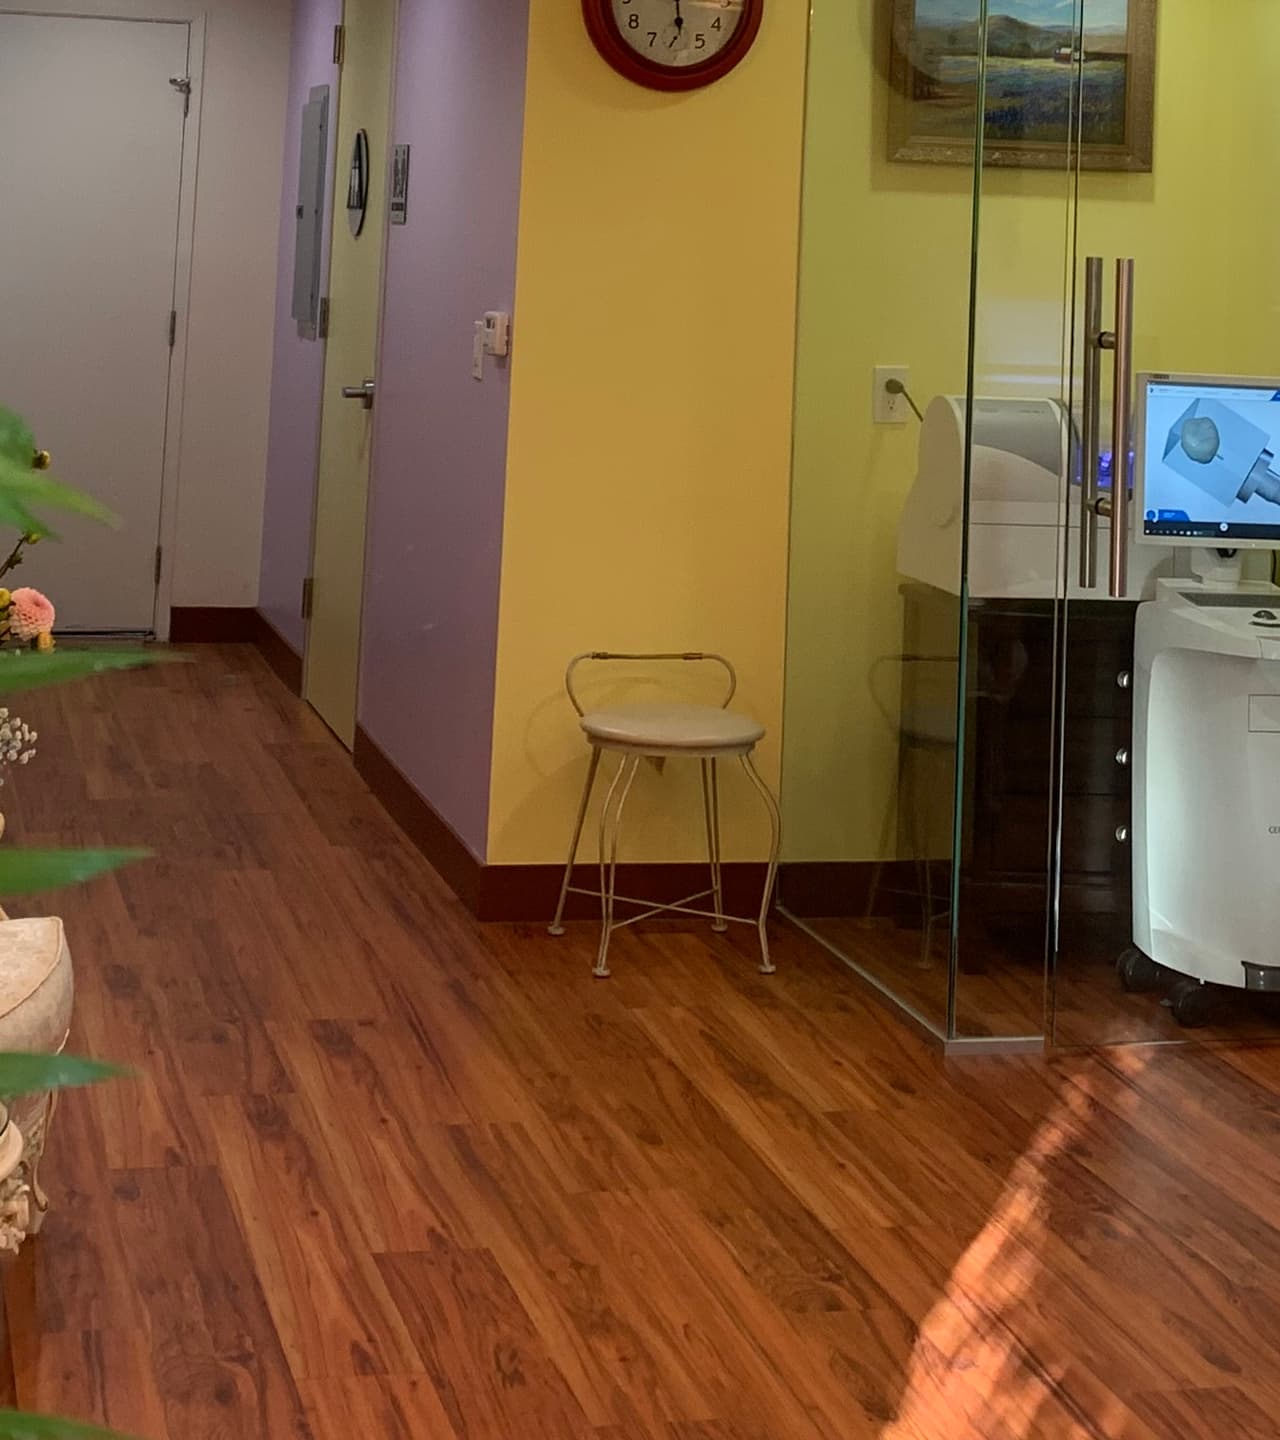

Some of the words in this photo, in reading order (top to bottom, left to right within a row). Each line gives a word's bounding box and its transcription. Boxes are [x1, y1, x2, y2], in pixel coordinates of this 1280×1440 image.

[628, 13, 639, 29] 8
[710, 16, 721, 32] 4
[647, 31, 657, 47] 7
[694, 33, 705, 49] 5
